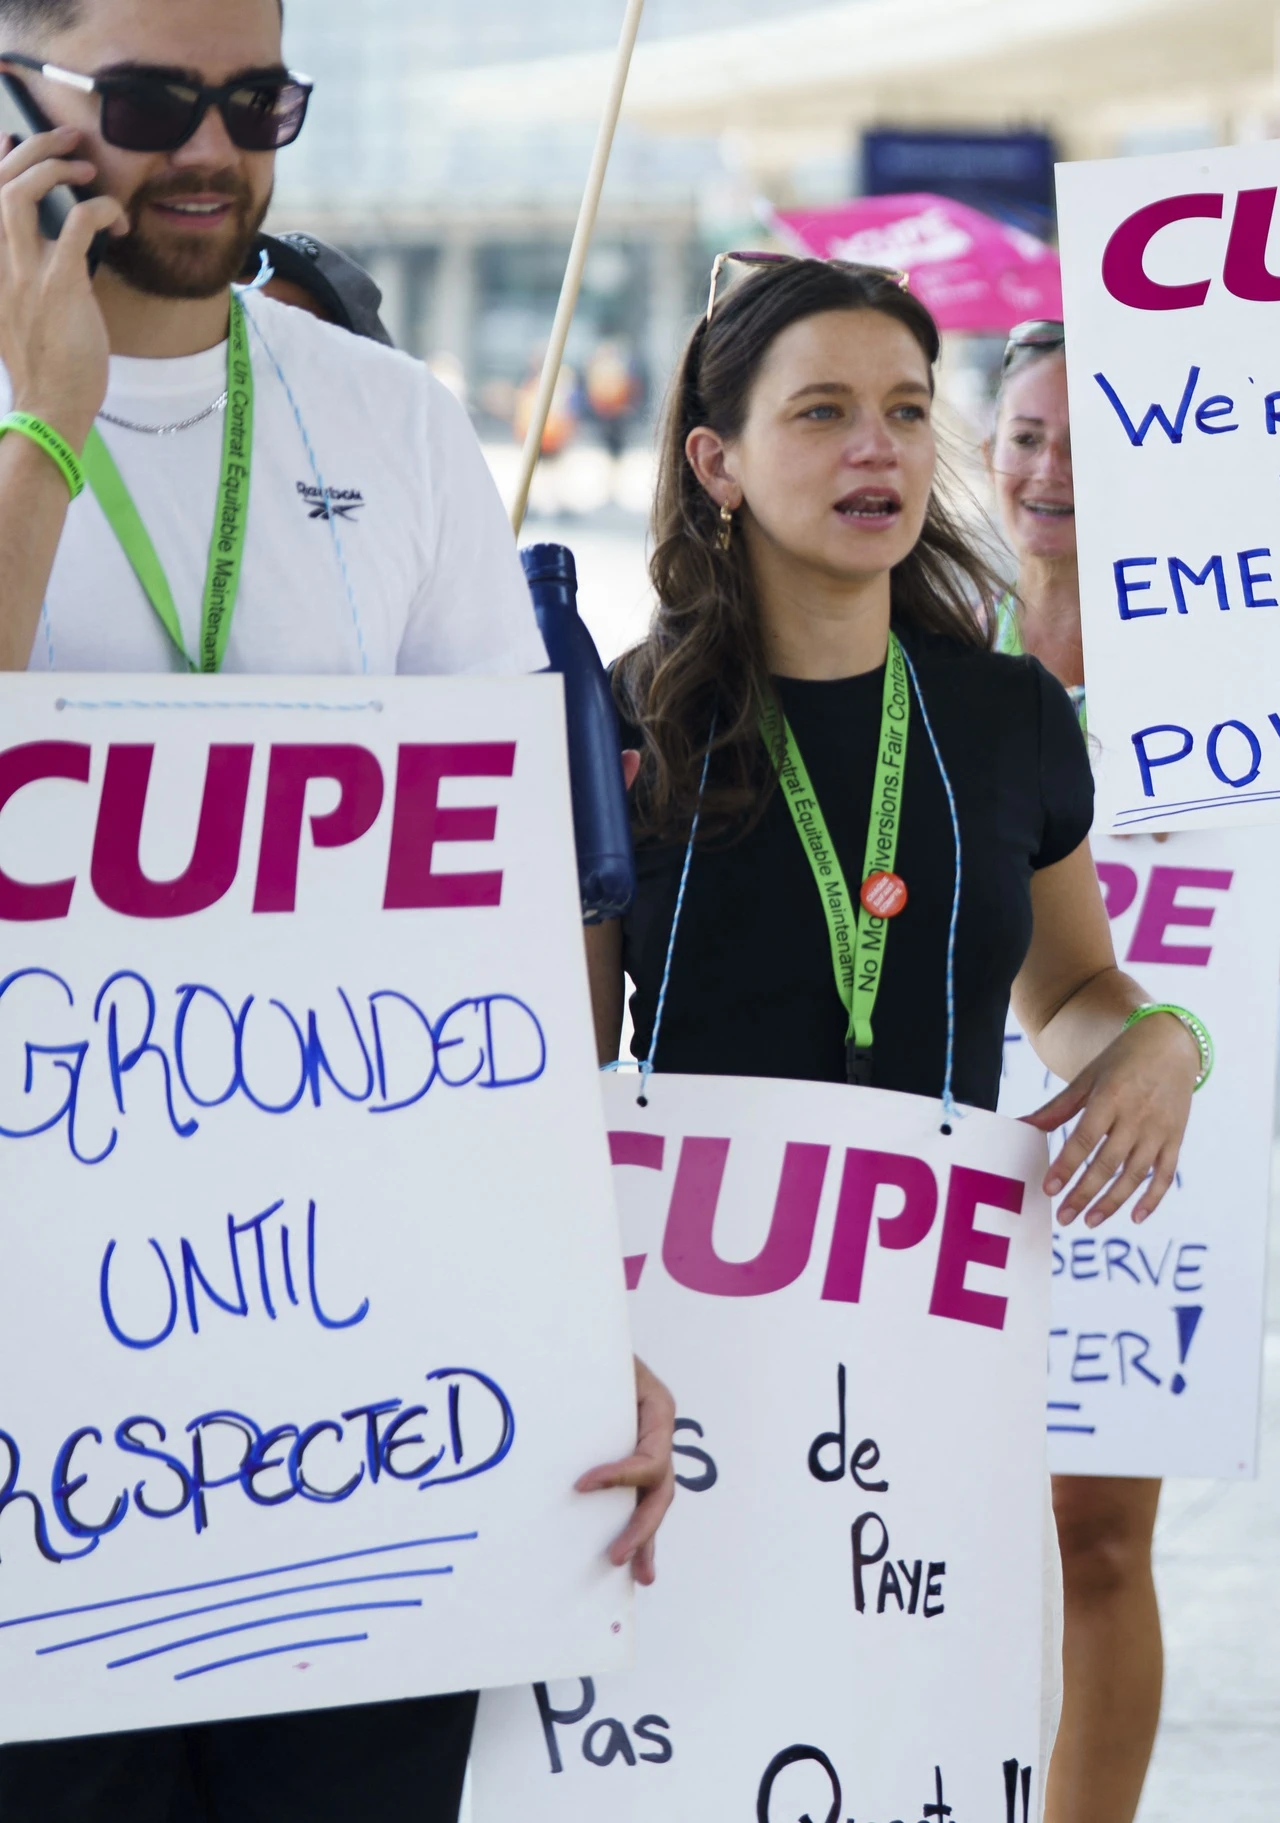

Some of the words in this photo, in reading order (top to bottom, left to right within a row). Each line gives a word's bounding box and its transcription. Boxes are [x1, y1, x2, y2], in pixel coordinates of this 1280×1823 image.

[228, 390, 249, 459] Contrat
[218, 463, 248, 552] Équitable
[795, 798, 832, 876] Équitable
[861, 916, 884, 951] Mo
[858, 960, 878, 992] No
[100, 1199, 370, 1350] UNTIL
[808, 1363, 889, 1492] de
[532, 1676, 673, 1774] Pas
